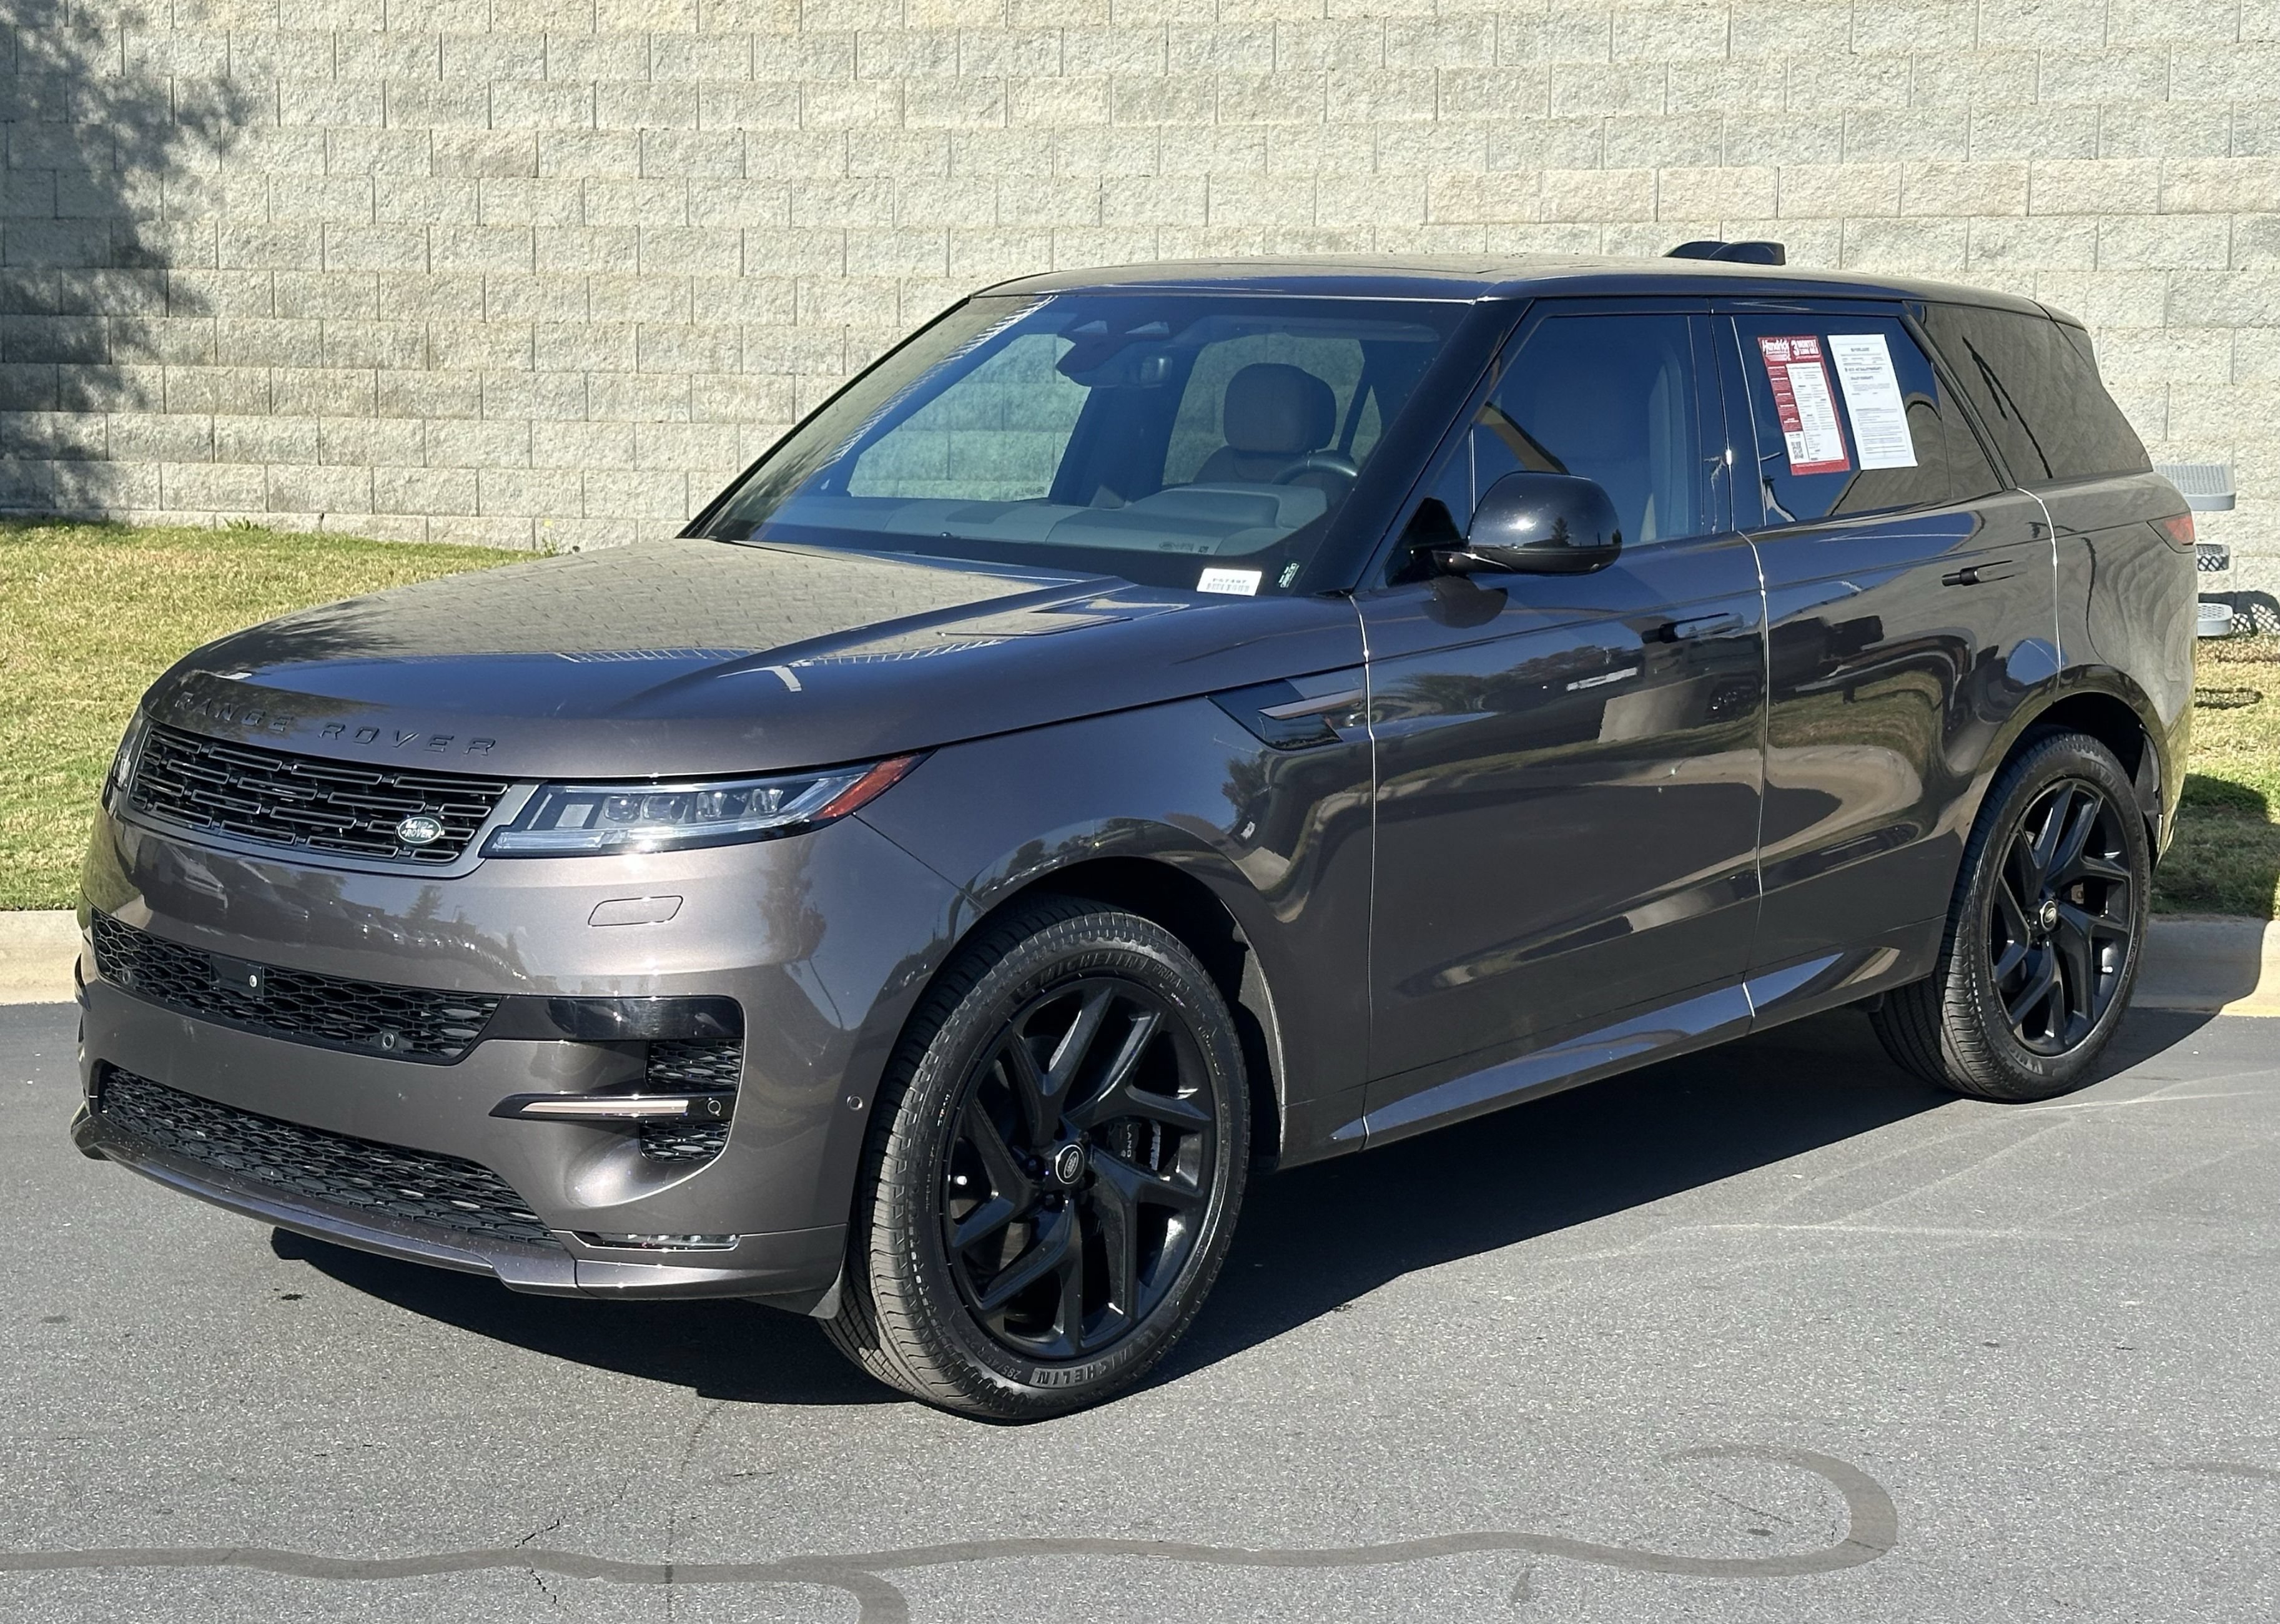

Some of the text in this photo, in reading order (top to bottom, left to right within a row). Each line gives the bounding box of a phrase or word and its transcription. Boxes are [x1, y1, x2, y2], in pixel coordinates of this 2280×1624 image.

[175, 691, 498, 757] RANGE ROVER
[1040, 952, 1139, 985] MICHELIN
[1037, 1343, 1135, 1385] MICHELIN
